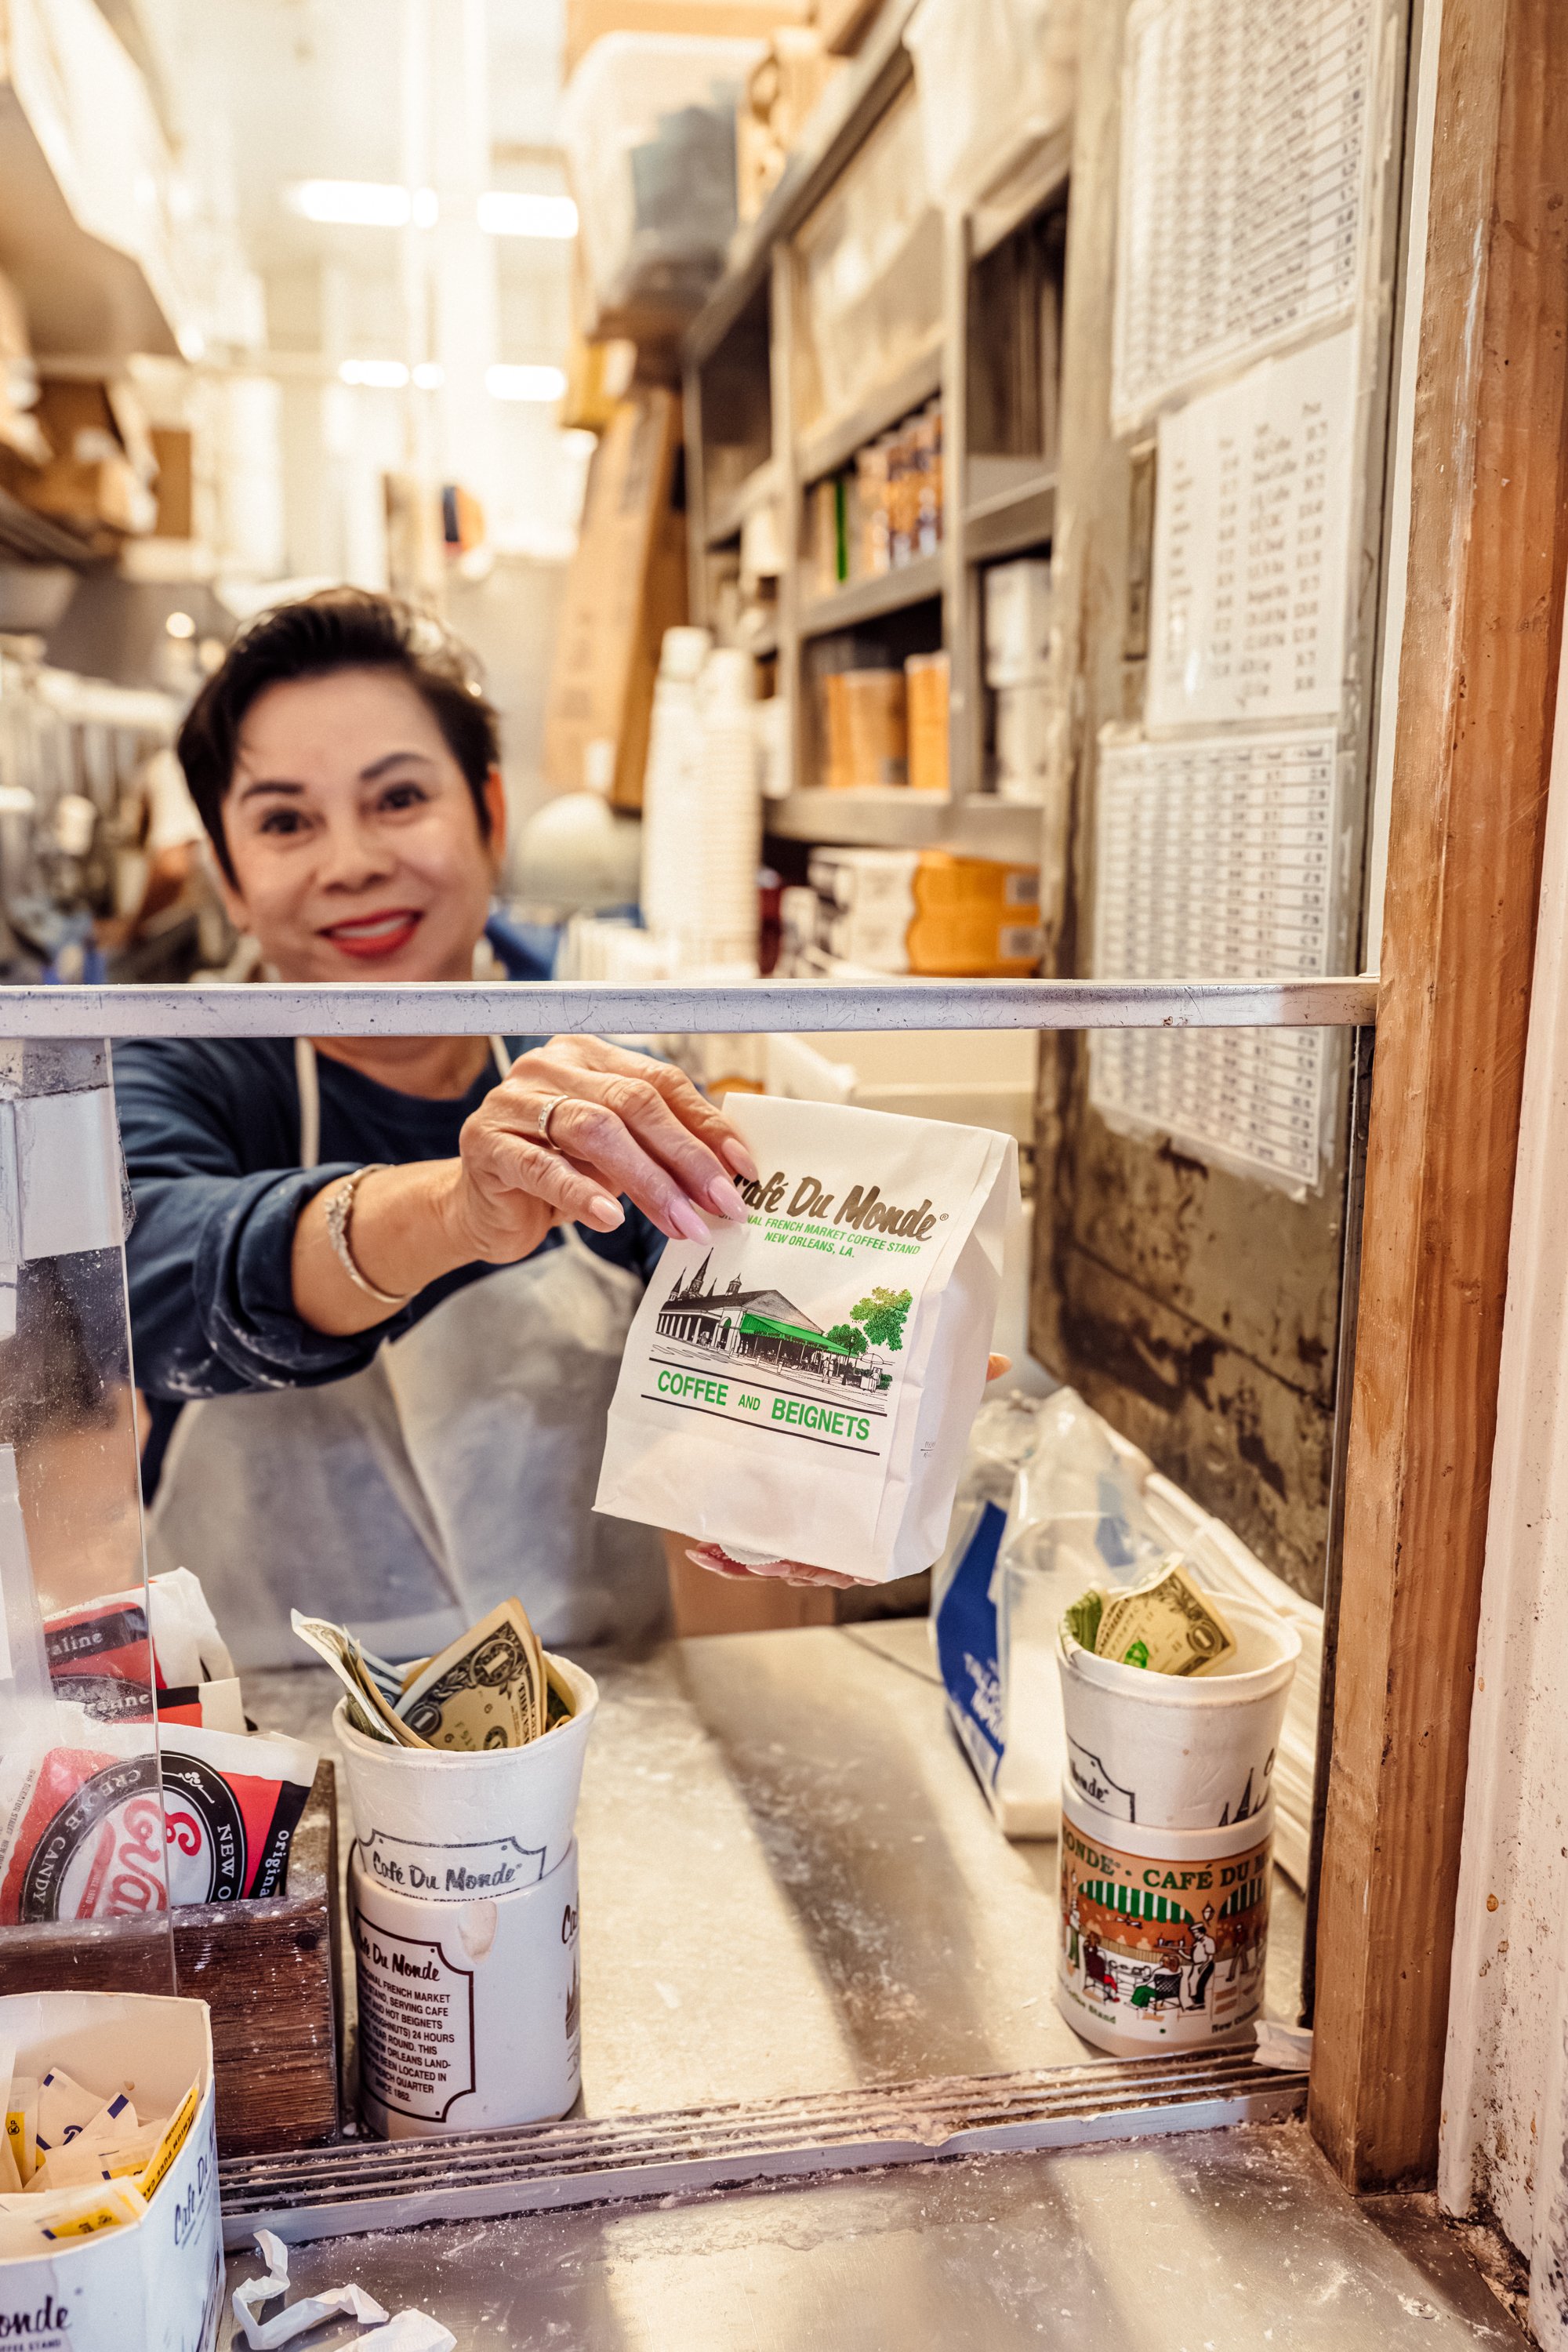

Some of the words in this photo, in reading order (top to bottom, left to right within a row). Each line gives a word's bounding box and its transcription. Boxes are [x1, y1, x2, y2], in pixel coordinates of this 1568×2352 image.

[786, 1177, 835, 1219] Du
[764, 1218, 804, 1233] FRENCH
[804, 1225, 848, 1241] MARKET
[847, 1233, 887, 1251] COFFEE
[887, 1242, 921, 1255] STAND
[764, 1231, 787, 1243] NEW
[789, 1236, 837, 1255] ORLEANS,
[839, 1247, 855, 1258] LA.
[658, 1370, 729, 1406] COFFEE
[738, 1394, 761, 1411] AND
[771, 1397, 870, 1441] BEIGNETS
[217, 1824, 234, 1878] NEW
[260, 1830, 289, 1897] origina
[33, 1836, 66, 1902] CANDY
[373, 1850, 405, 1885] Café
[408, 1864, 440, 1890] Du
[1142, 1863, 1214, 1890] CAFÉ
[1220, 1857, 1251, 1887] DU
[372, 1943, 390, 1969] Du
[392, 1952, 441, 1982] Monde
[383, 1980, 412, 1999] FRENCH
[414, 1991, 451, 2004] MARKET
[390, 1996, 423, 2014] SERVING
[425, 2006, 449, 2016] CAFE
[385, 2007, 400, 2021] HOT
[401, 2013, 443, 2030] BEIGNETS
[387, 2034, 417, 2053] ROUND.
[418, 2044, 437, 2055] THIS
[412, 2031, 422, 2039] 24
[423, 2032, 456, 2043] HOURS
[387, 2047, 423, 2066] ORLEANS
[424, 2058, 452, 2069] LAND-
[398, 2064, 436, 2081] LOCATED
[437, 2072, 447, 2082] IN
[396, 2076, 434, 2094] QUARTER
[0, 2294, 73, 2337] onde
